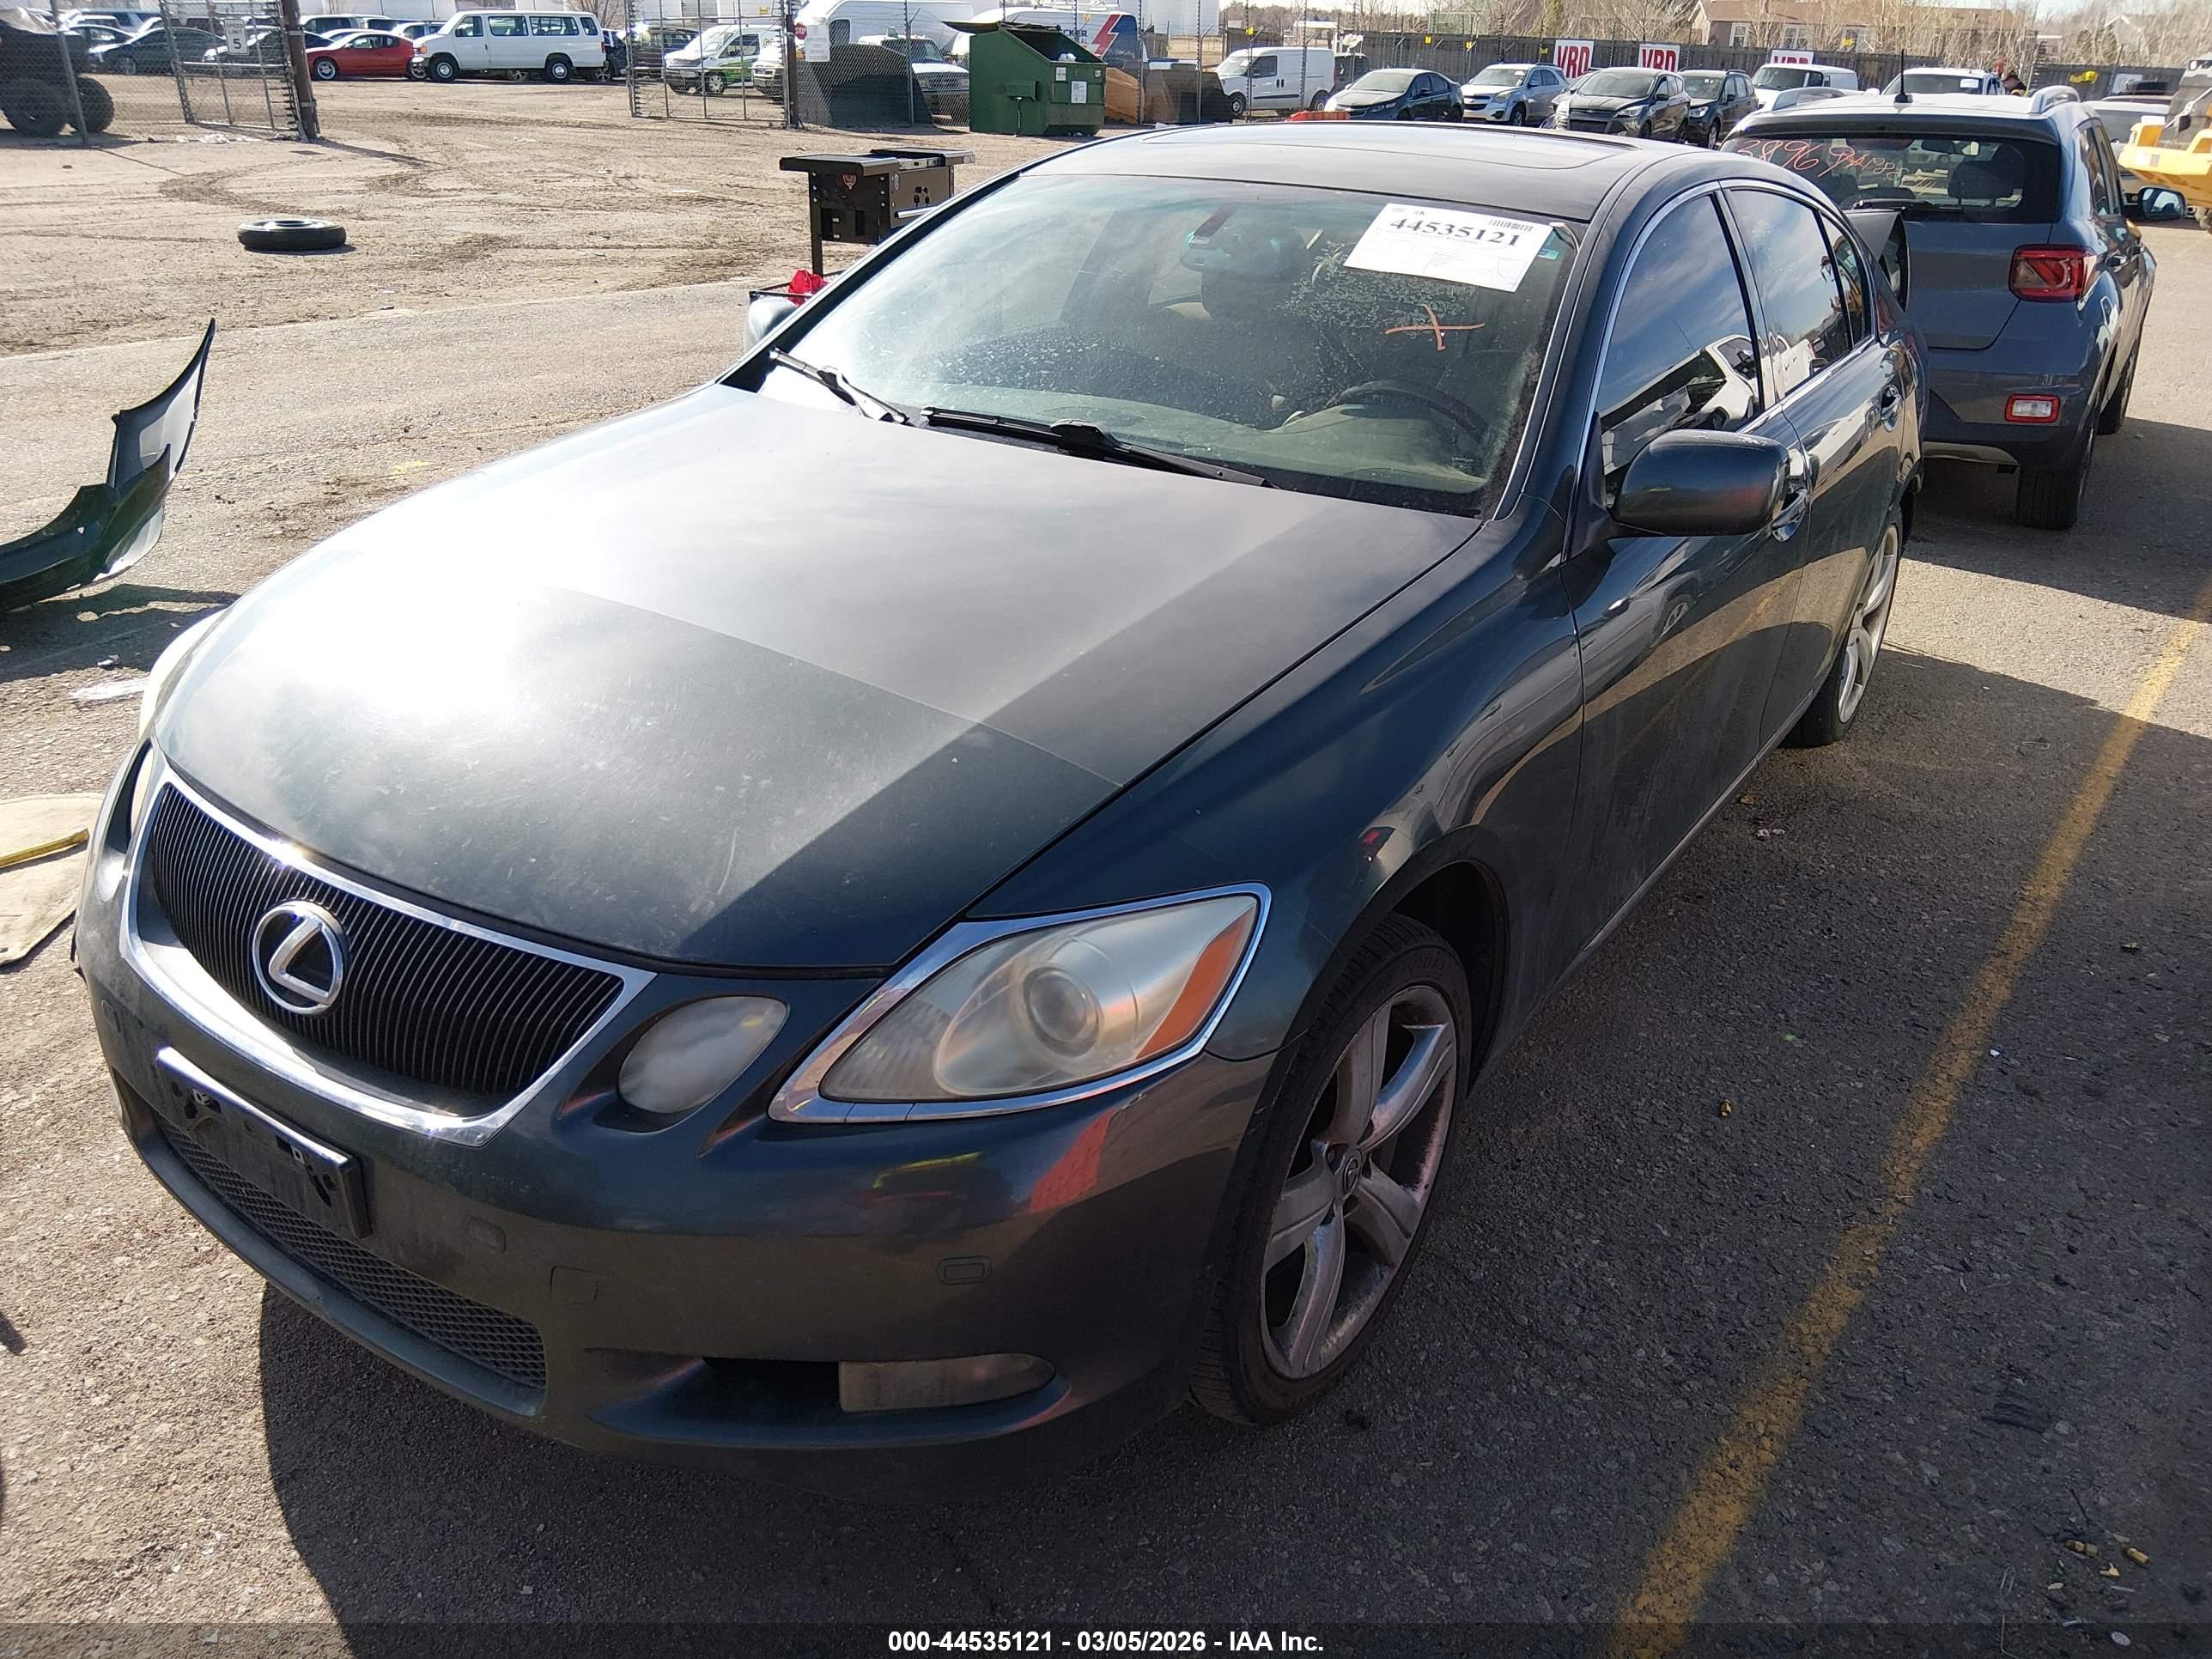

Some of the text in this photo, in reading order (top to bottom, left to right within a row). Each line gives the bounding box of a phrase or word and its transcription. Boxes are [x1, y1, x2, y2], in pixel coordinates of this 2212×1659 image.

[794, 27, 806, 35] STOP
[233, 38, 242, 50] 5
[1557, 45, 1590, 78] VRD
[1389, 218, 1521, 246] 44535121
